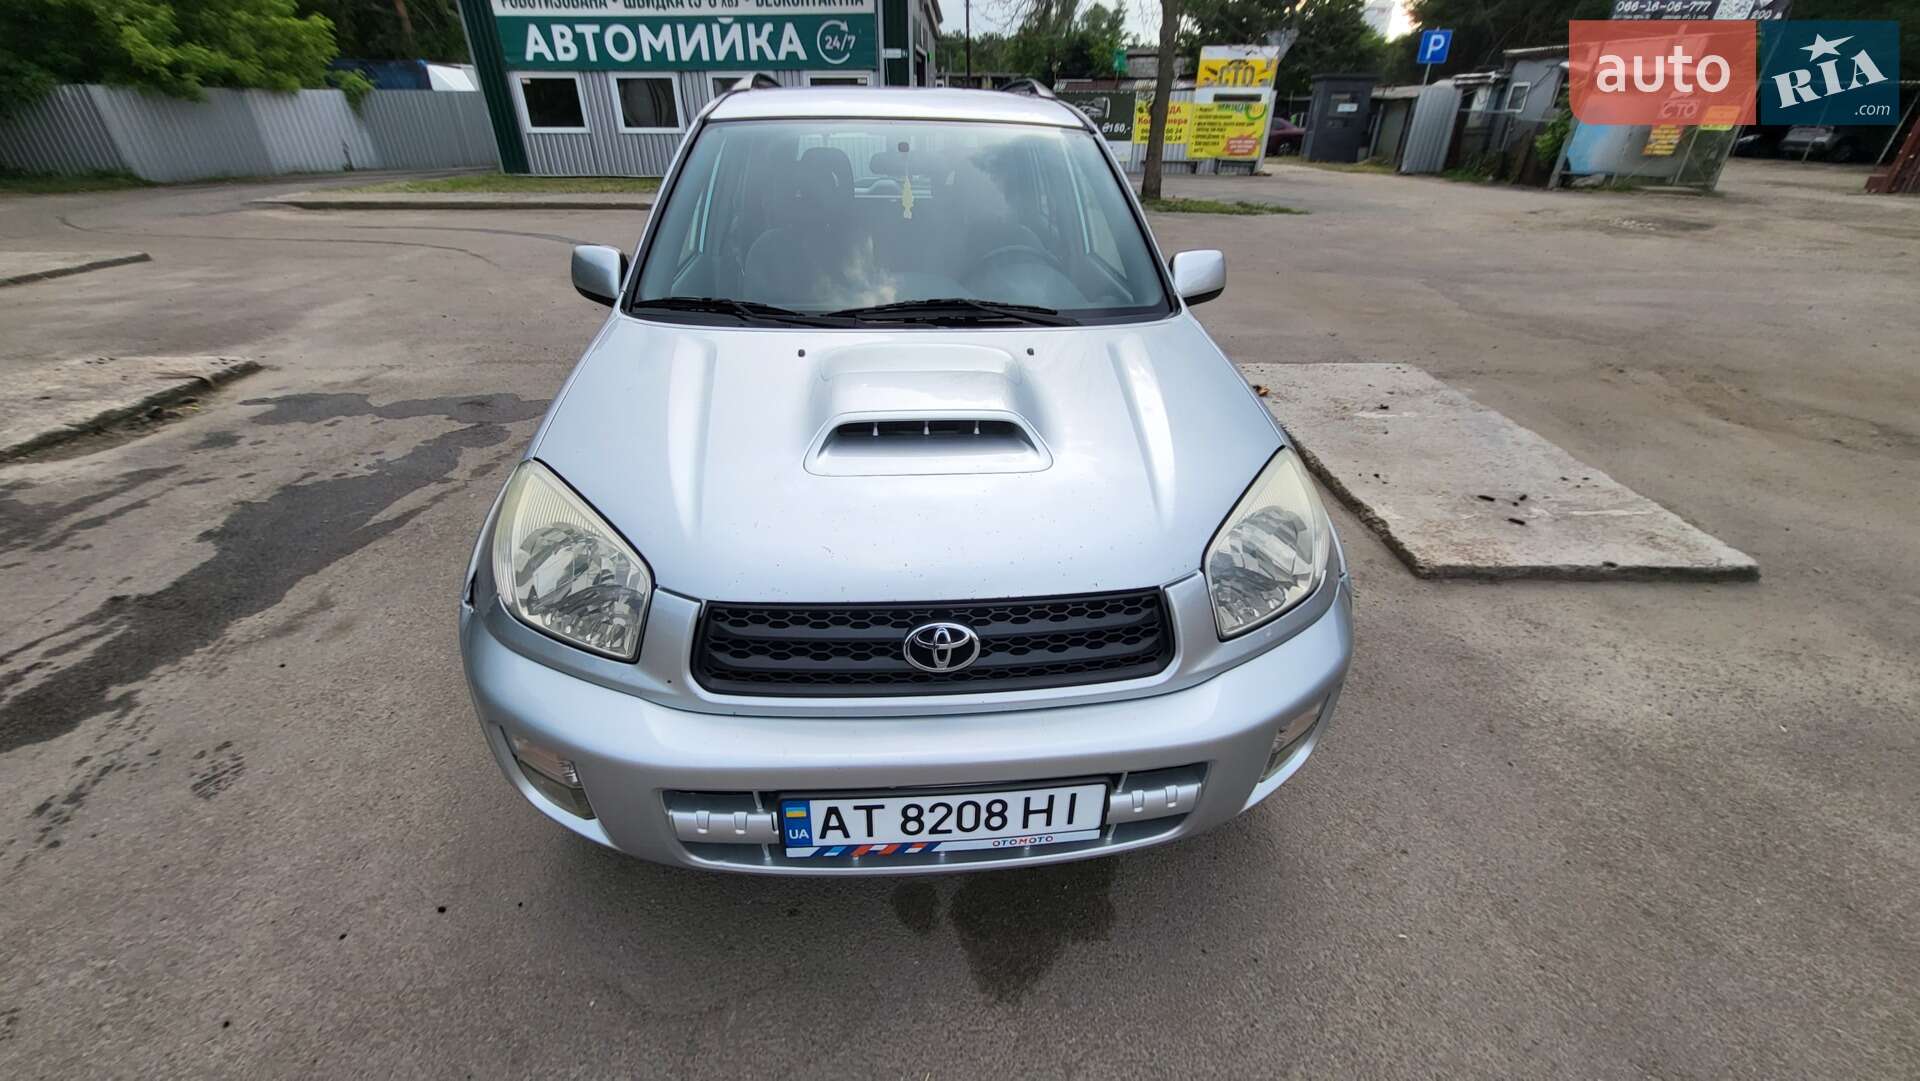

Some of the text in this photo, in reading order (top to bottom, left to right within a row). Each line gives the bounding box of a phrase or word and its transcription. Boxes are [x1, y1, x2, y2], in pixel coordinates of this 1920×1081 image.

[525, 17, 855, 62] АВТОМИЙКА 24/7
[1426, 34, 1445, 60] P
[819, 792, 1077, 839] AT 8208 HI
[789, 829, 809, 839] UA
[992, 835, 1054, 847] OTOMOTO
